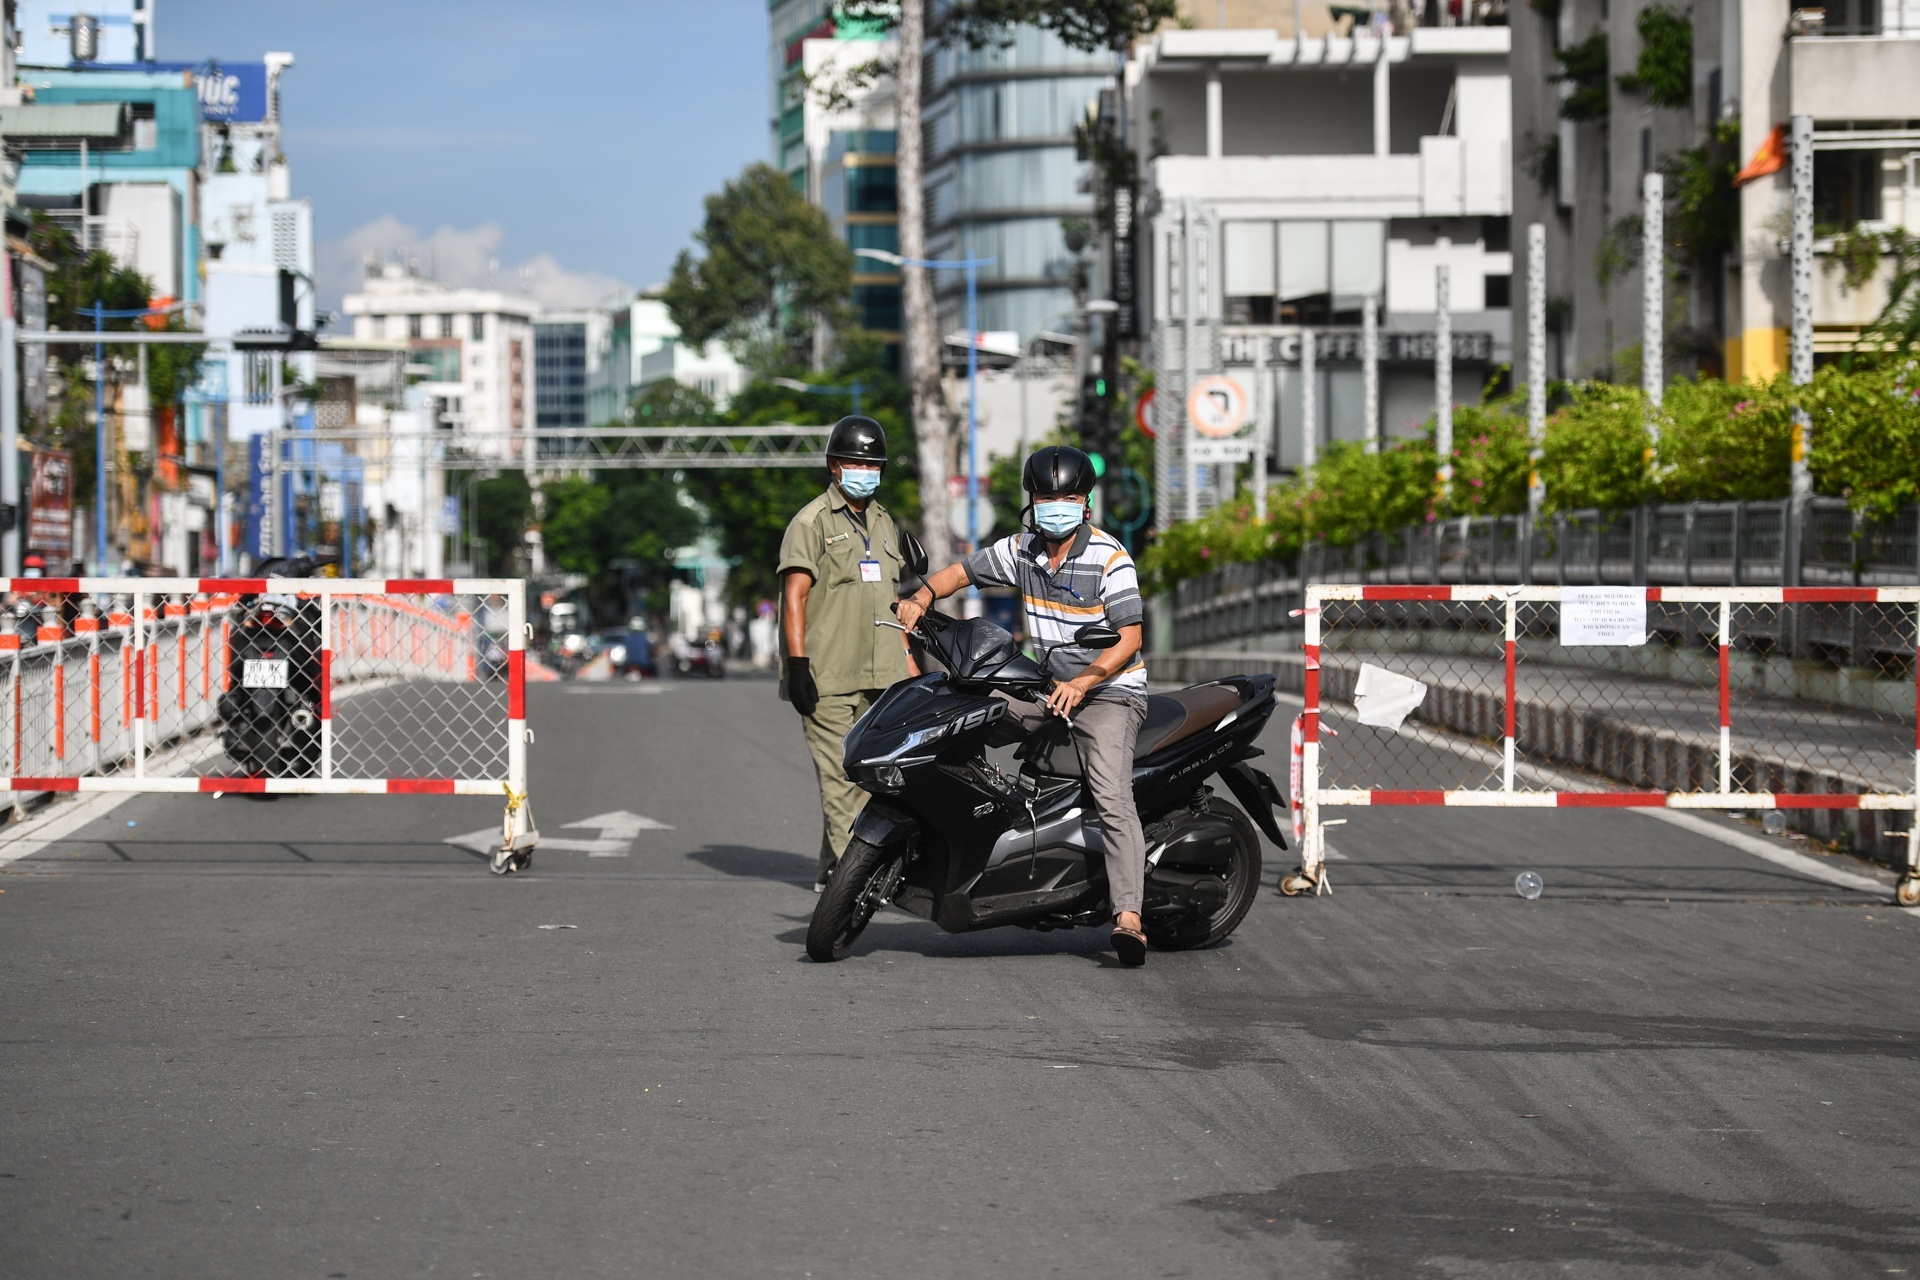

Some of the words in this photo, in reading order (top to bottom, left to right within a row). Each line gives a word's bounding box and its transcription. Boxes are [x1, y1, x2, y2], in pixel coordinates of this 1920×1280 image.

[1279, 337, 1393, 361] CFFE
[1402, 337, 1489, 361] HOSE
[952, 700, 1009, 735] 150
